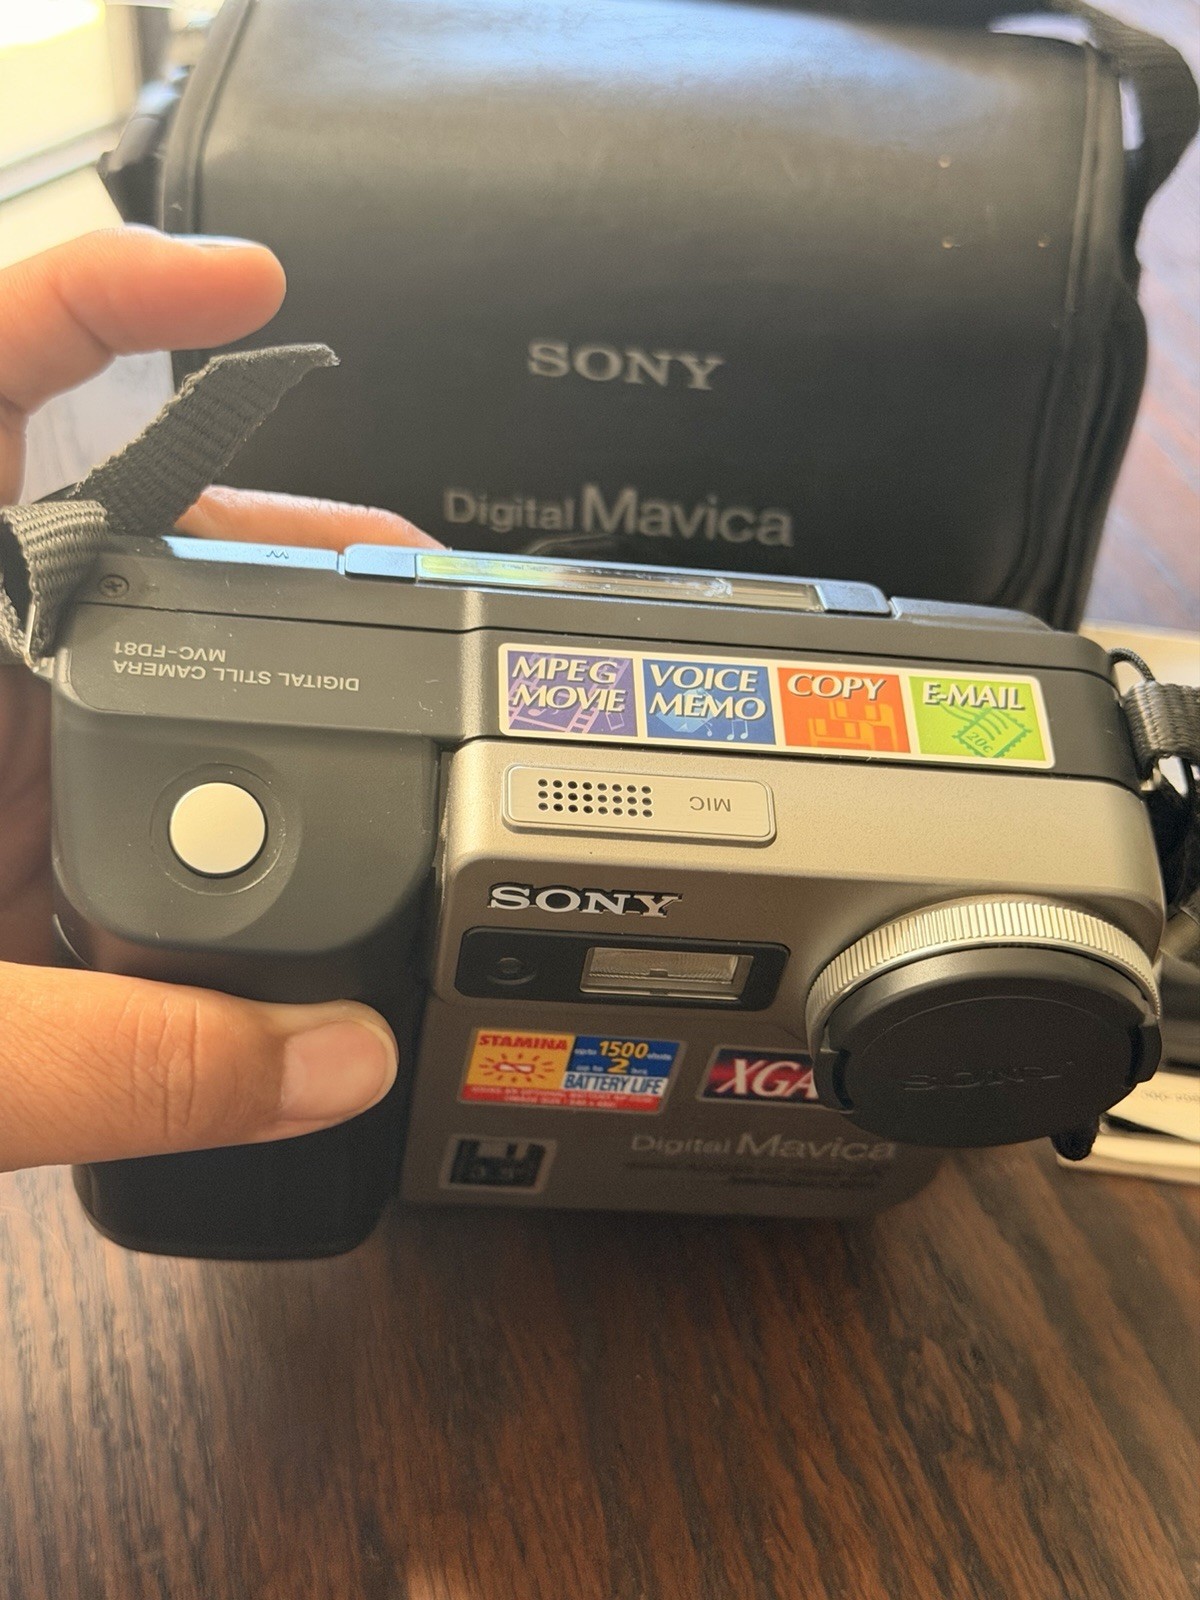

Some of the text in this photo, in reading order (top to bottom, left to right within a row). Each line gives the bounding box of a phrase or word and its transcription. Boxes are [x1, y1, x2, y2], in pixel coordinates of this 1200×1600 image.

[527, 340, 724, 391] SONY
[444, 483, 794, 548] Digital Mavica
[114, 641, 227, 663] MVC-FD81
[112, 660, 360, 692] DIGITAL STILL CAMERA
[511, 655, 619, 684] MPEG
[649, 663, 759, 693] VOICE
[512, 683, 627, 713] MOVIE
[787, 672, 888, 701] COPY
[921, 680, 1026, 710] E-MAIL
[649, 691, 767, 721] MEMO
[688, 795, 732, 813] MIC
[487, 882, 683, 918] SONY
[478, 1034, 569, 1051] STAMINA
[600, 1040, 650, 1060] 1500
[607, 1058, 631, 1074] 2
[715, 1058, 818, 1099] XGA
[564, 1073, 664, 1094] BATTERY LIFE
[630, 1132, 897, 1161] Digital Mavica
